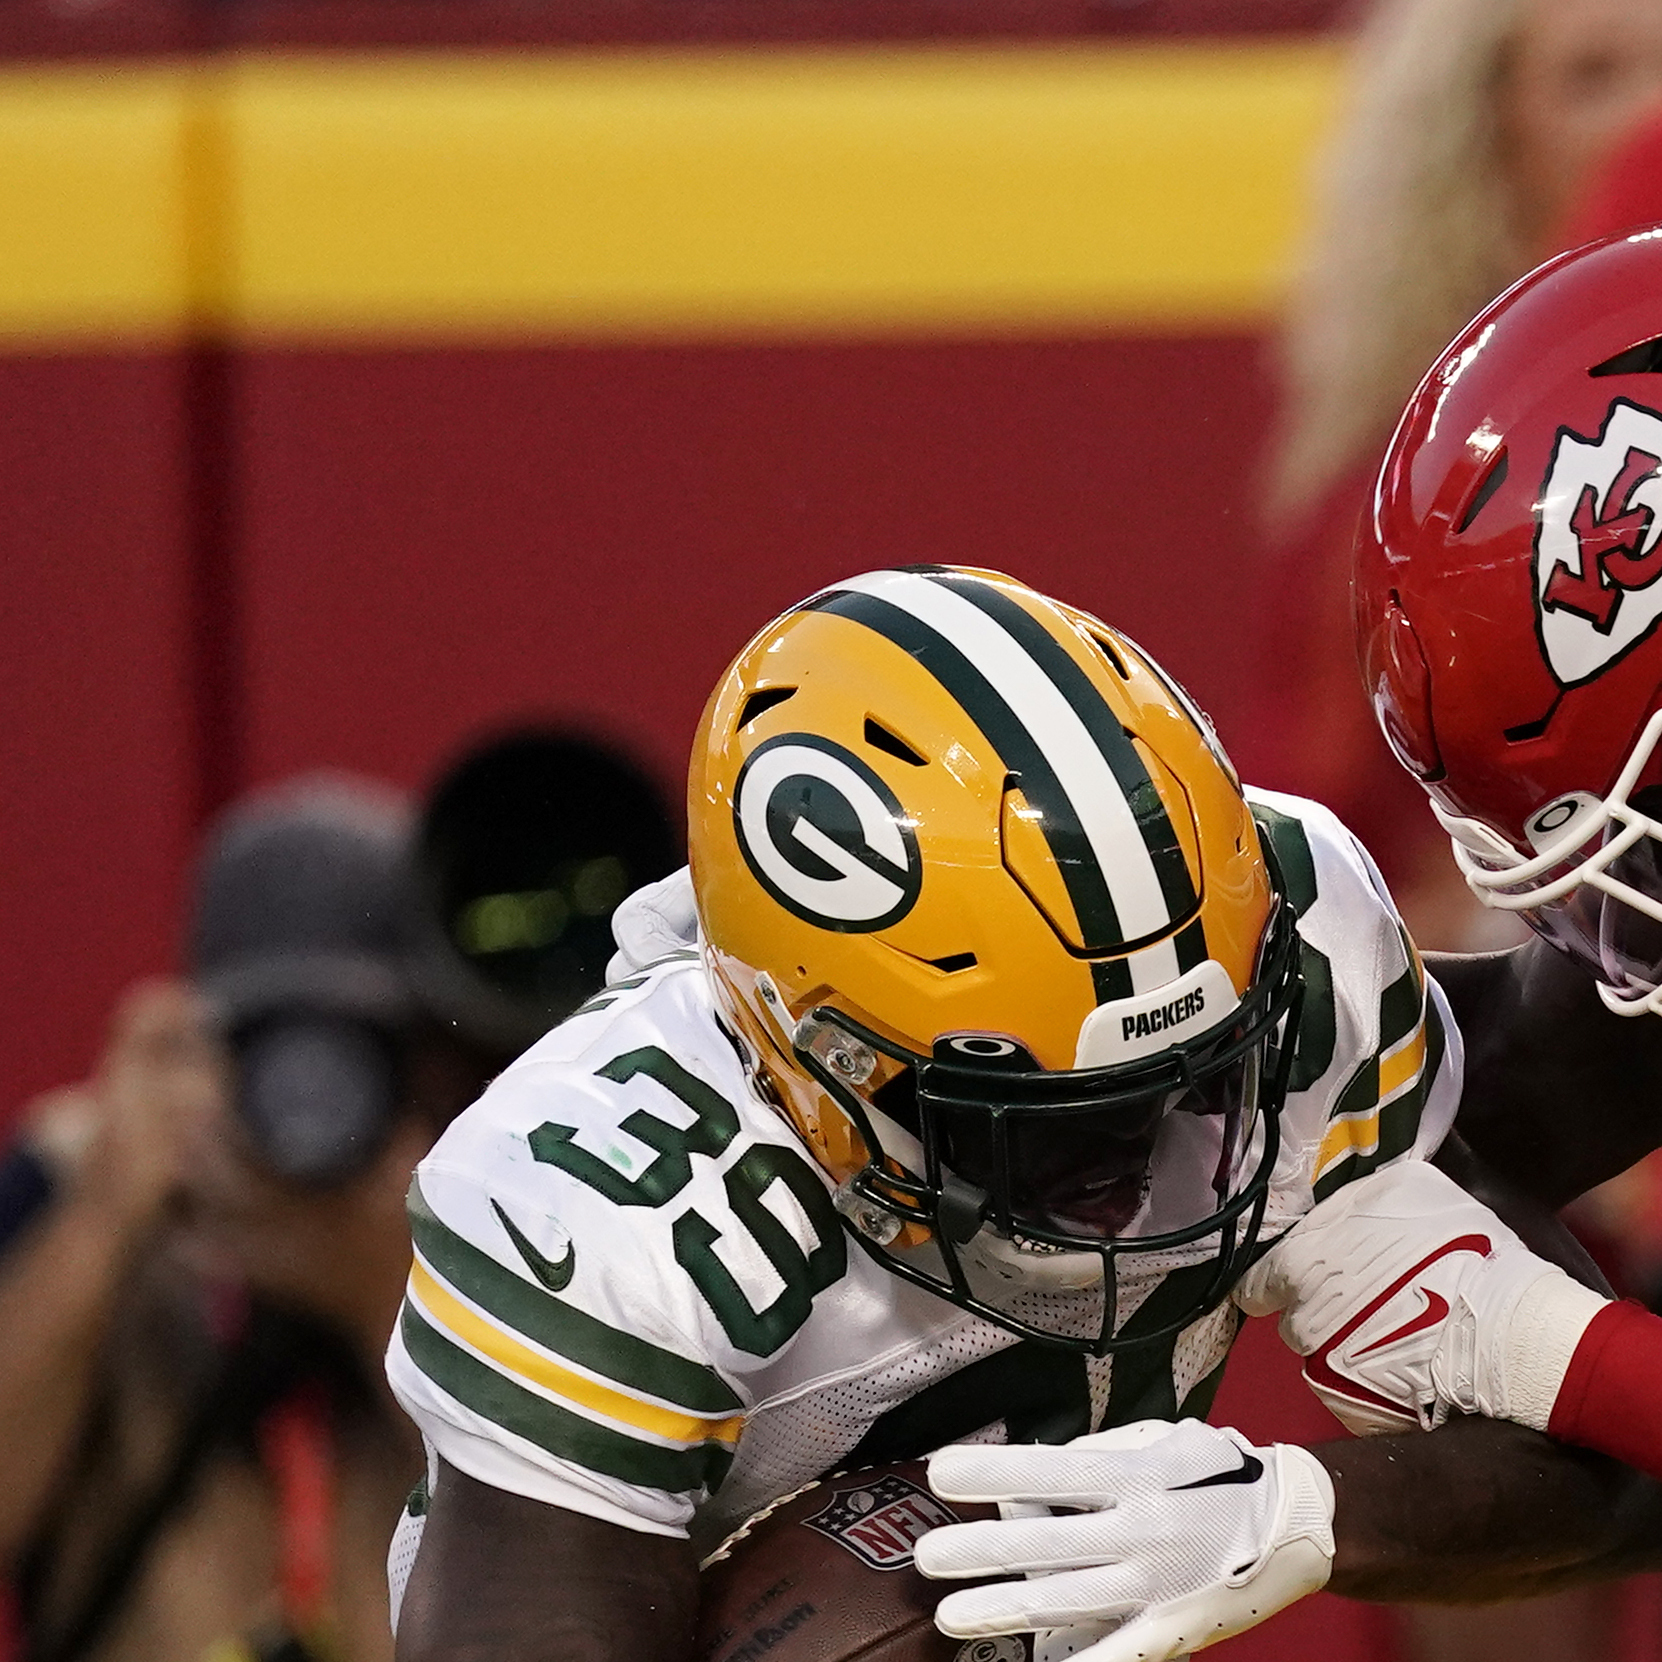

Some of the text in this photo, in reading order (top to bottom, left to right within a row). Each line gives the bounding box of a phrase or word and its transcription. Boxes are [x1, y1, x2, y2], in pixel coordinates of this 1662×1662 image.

[735, 736, 919, 930] G
[1121, 986, 1206, 1042] PACKERS
[526, 1044, 849, 1359] 39
[846, 1498, 946, 1561] NFL
